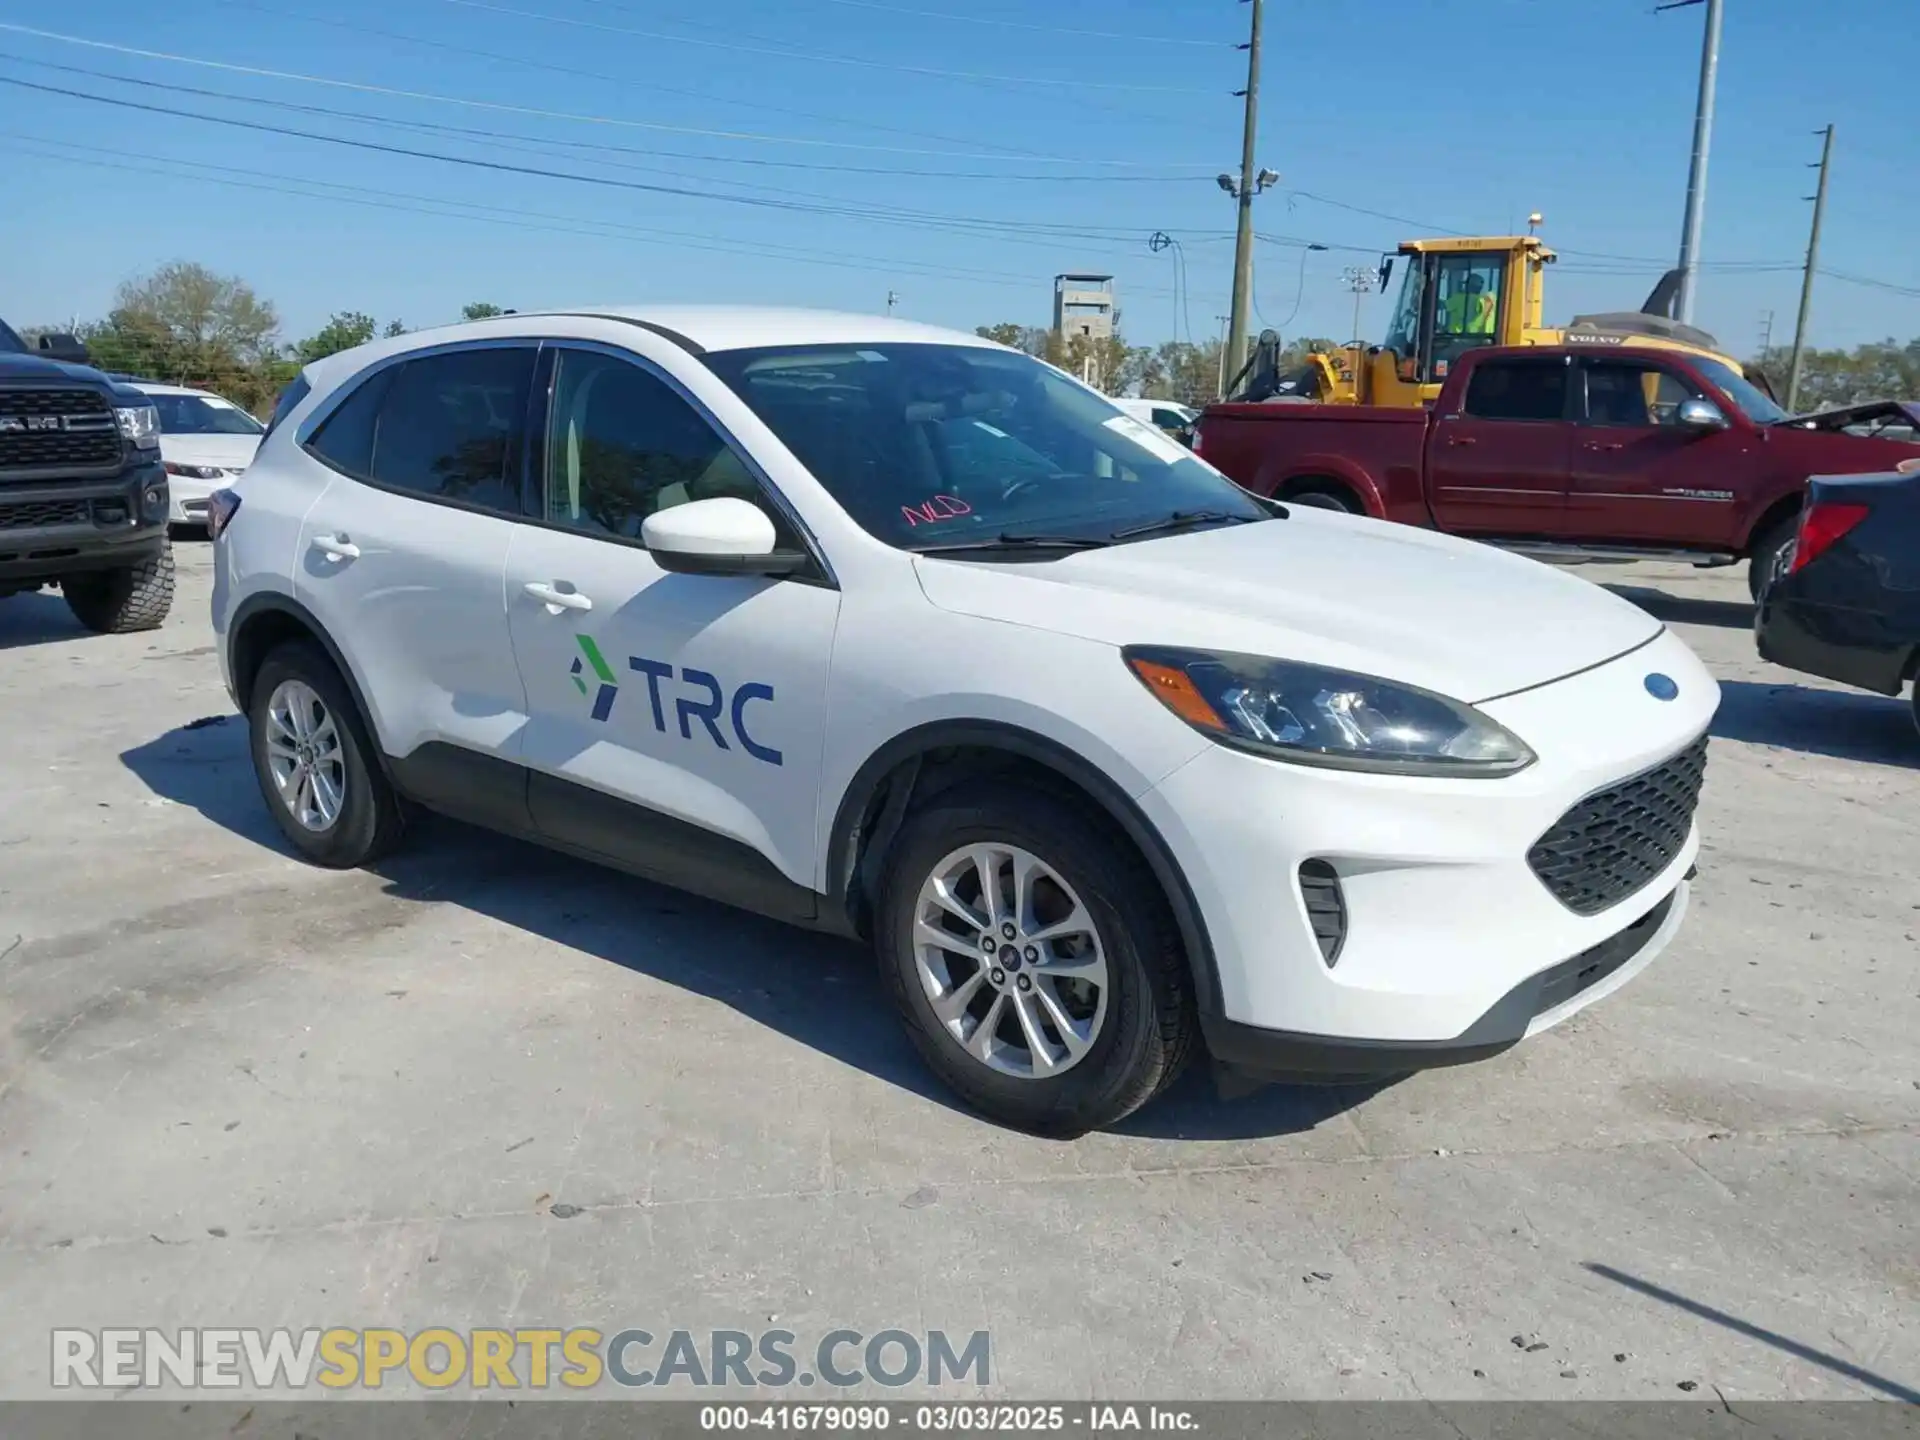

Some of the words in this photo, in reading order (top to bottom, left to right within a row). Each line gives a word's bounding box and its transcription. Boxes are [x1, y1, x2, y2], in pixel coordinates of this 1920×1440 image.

[0, 416, 58, 431] AM
[901, 495, 971, 526] NLD
[629, 656, 783, 766] TRC
